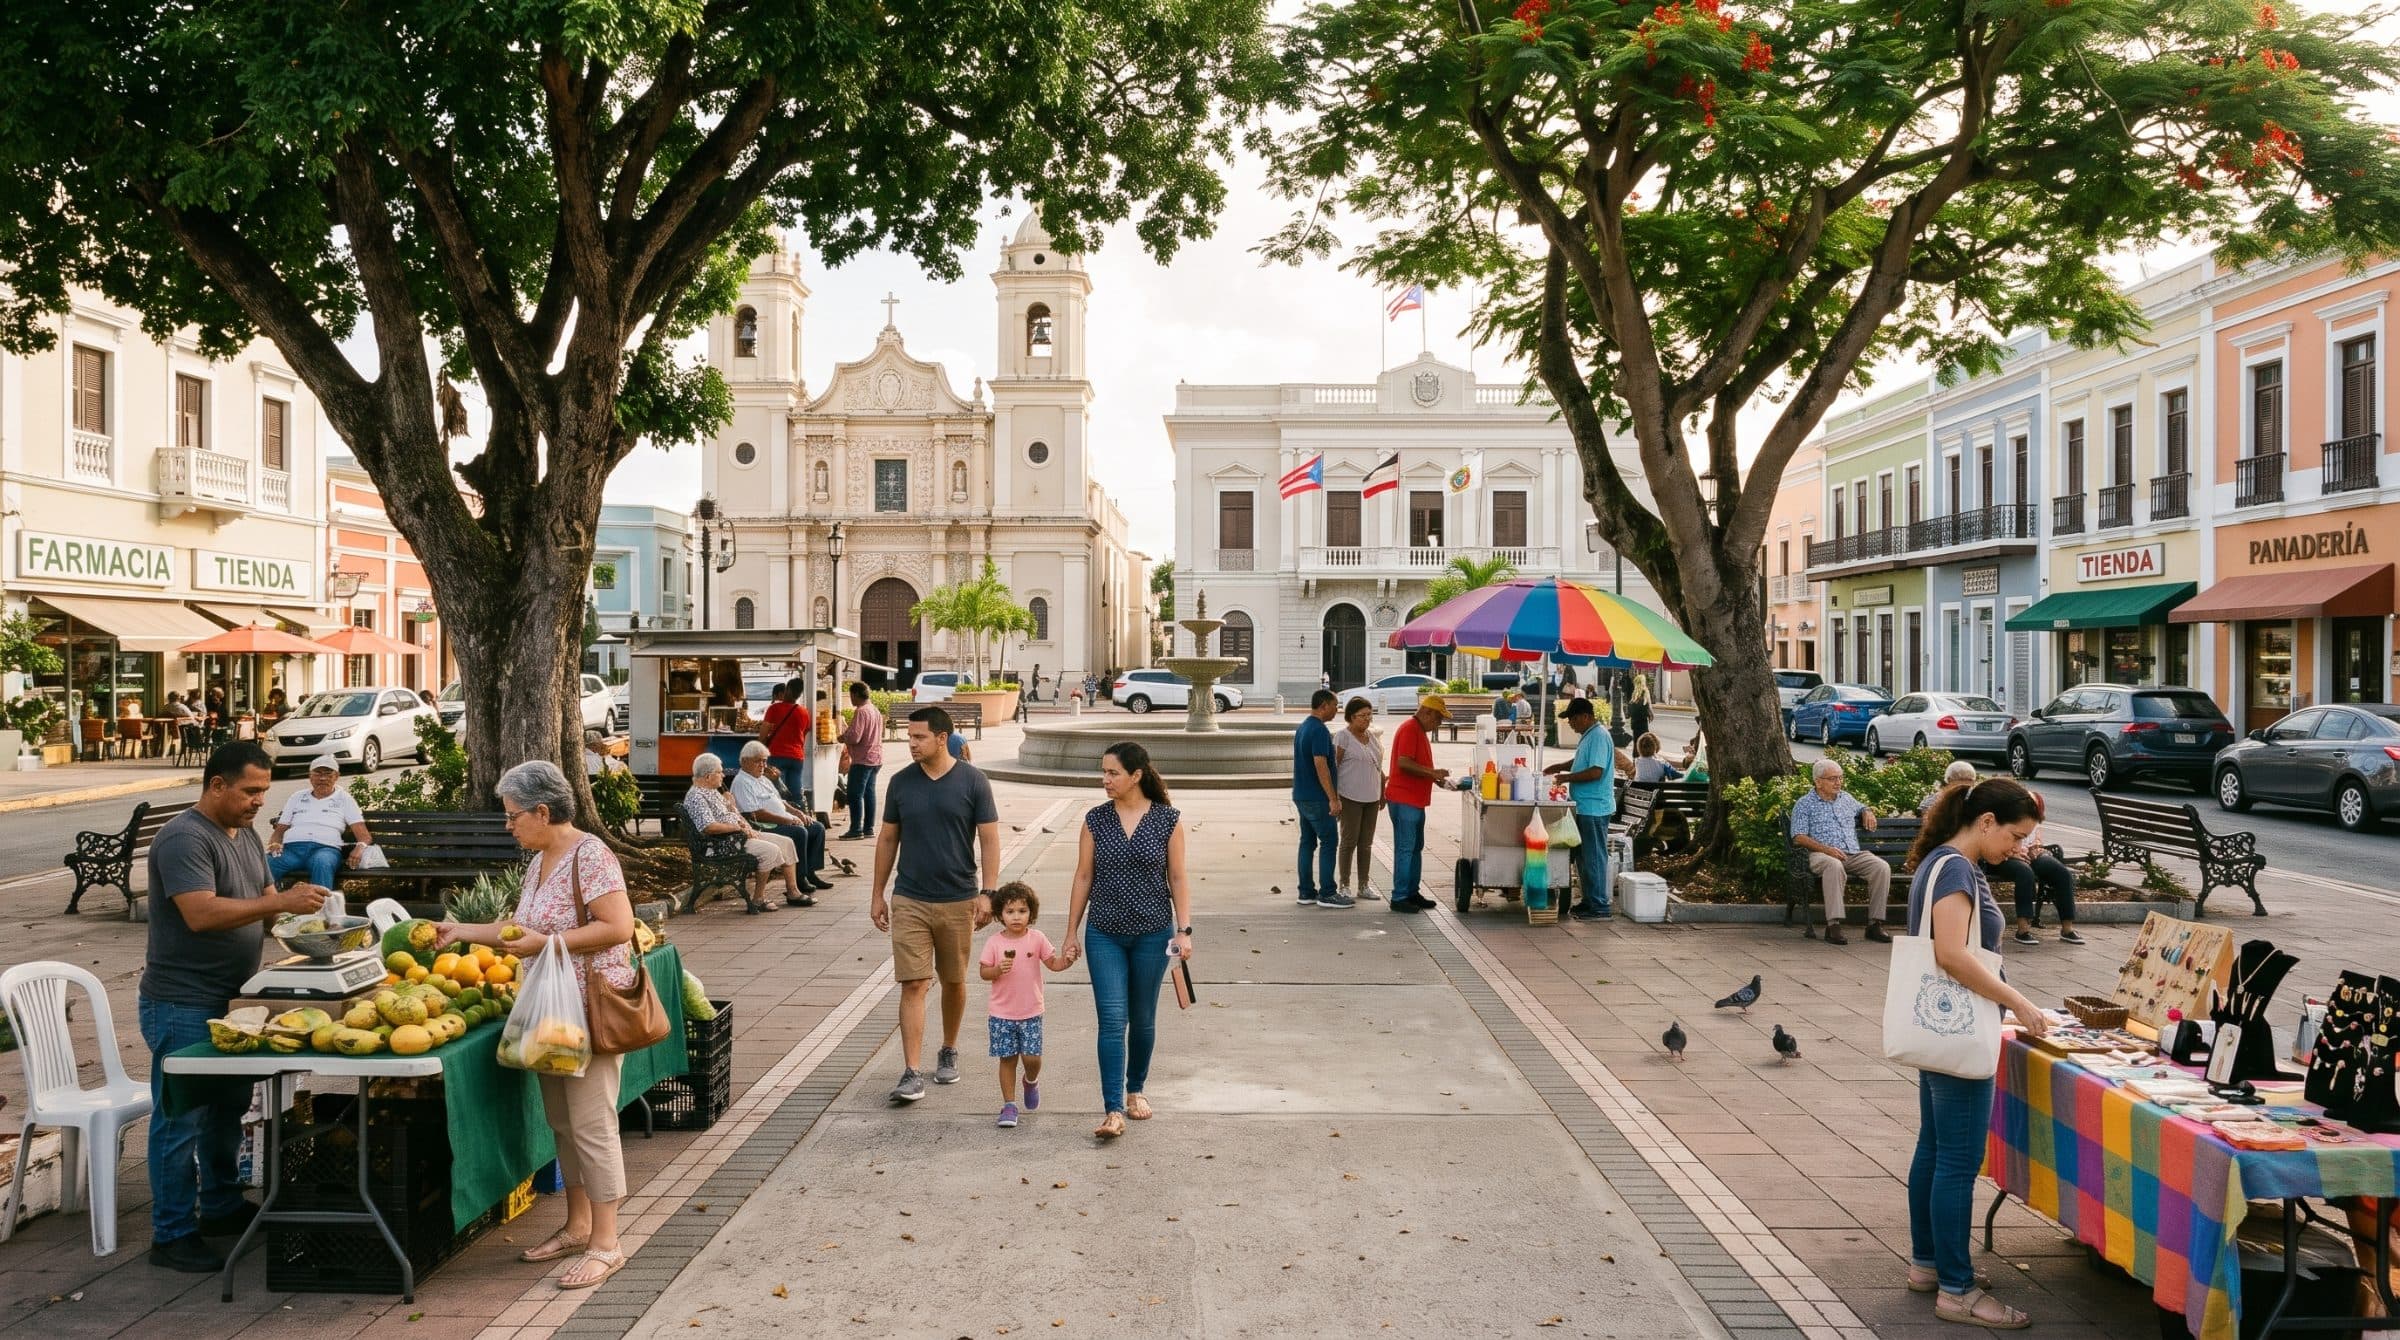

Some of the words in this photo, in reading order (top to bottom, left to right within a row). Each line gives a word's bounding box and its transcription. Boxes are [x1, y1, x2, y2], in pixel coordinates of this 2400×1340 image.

[28, 537, 171, 581] FARMACIA
[2249, 521, 2369, 565] PANADERÍA
[214, 556, 295, 590] TIENDA
[2082, 549, 2154, 578] TIENDA
